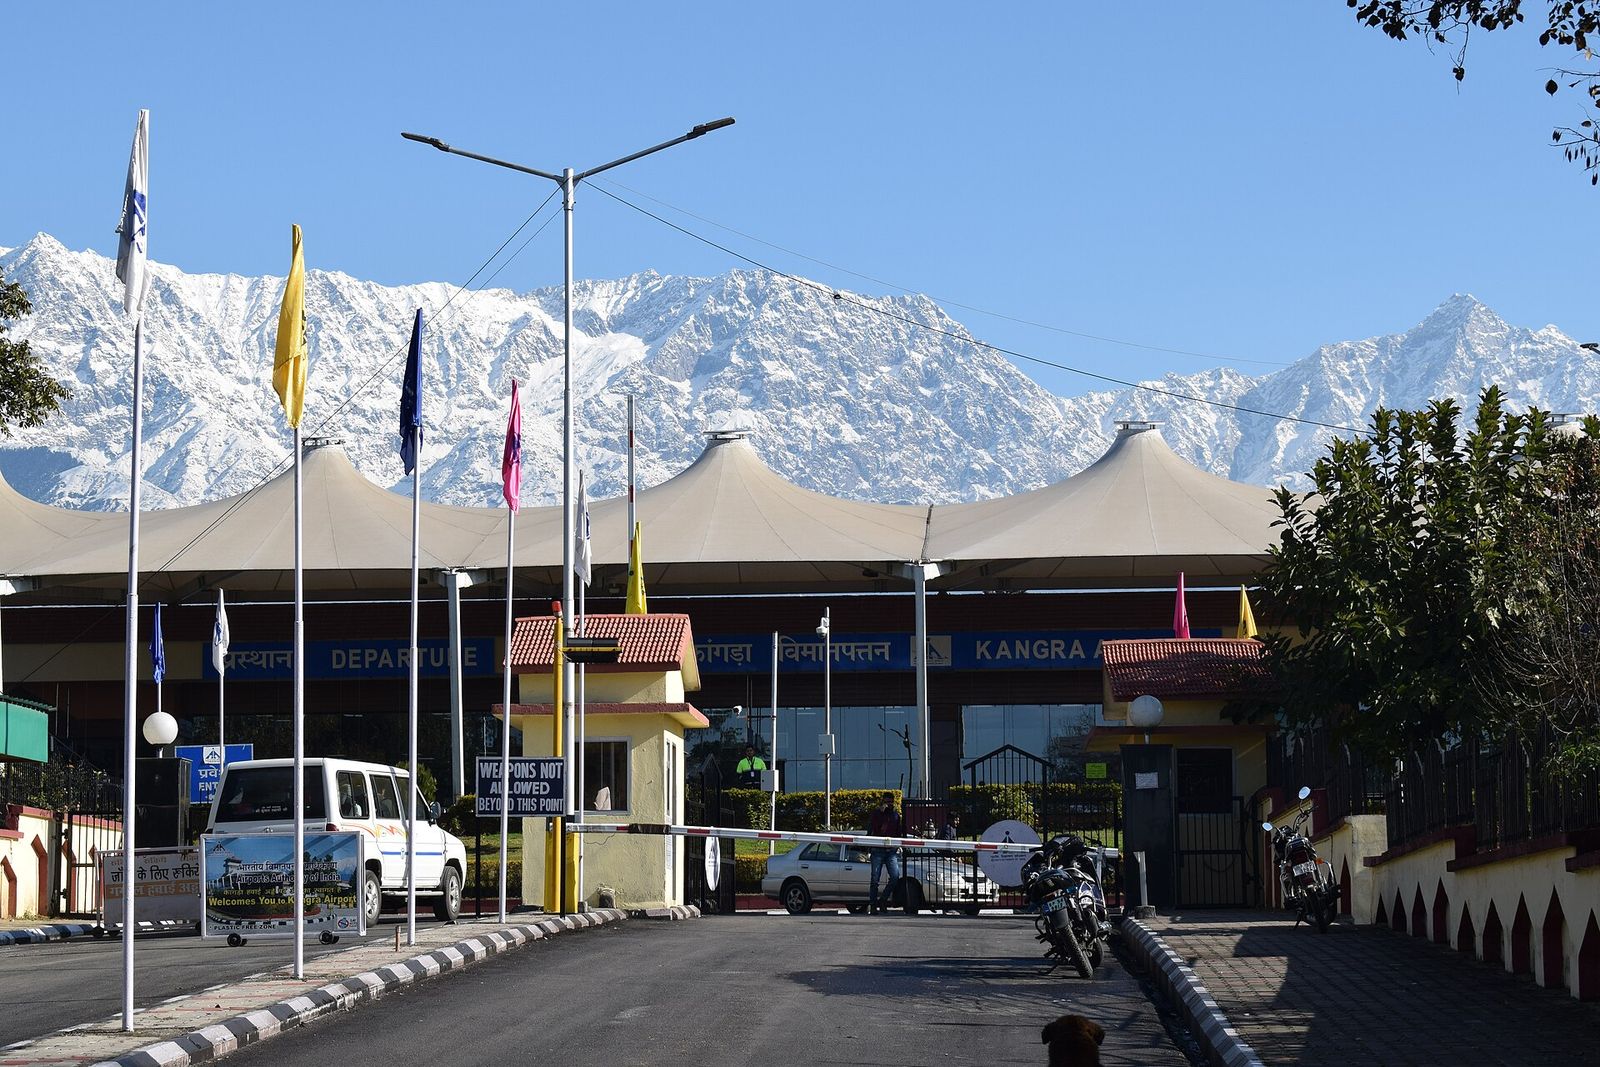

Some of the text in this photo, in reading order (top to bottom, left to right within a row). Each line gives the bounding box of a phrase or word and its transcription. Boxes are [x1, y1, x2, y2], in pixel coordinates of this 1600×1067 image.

[975, 639, 1086, 660] KANGRA
[332, 646, 478, 669] DEPARTUE
[198, 765, 221, 779] प्रवे
[540, 762, 563, 779] NOT
[198, 782, 218, 791] ENT
[478, 797, 564, 812] BEYOD THIS POINT
[137, 866, 148, 881] के
[150, 864, 169, 880] लिए
[235, 872, 342, 885] Airports Authoy of India
[208, 897, 256, 906] Welcomes
[258, 896, 276, 905] You
[287, 896, 321, 906] Kgra
[323, 895, 357, 905] Airport
